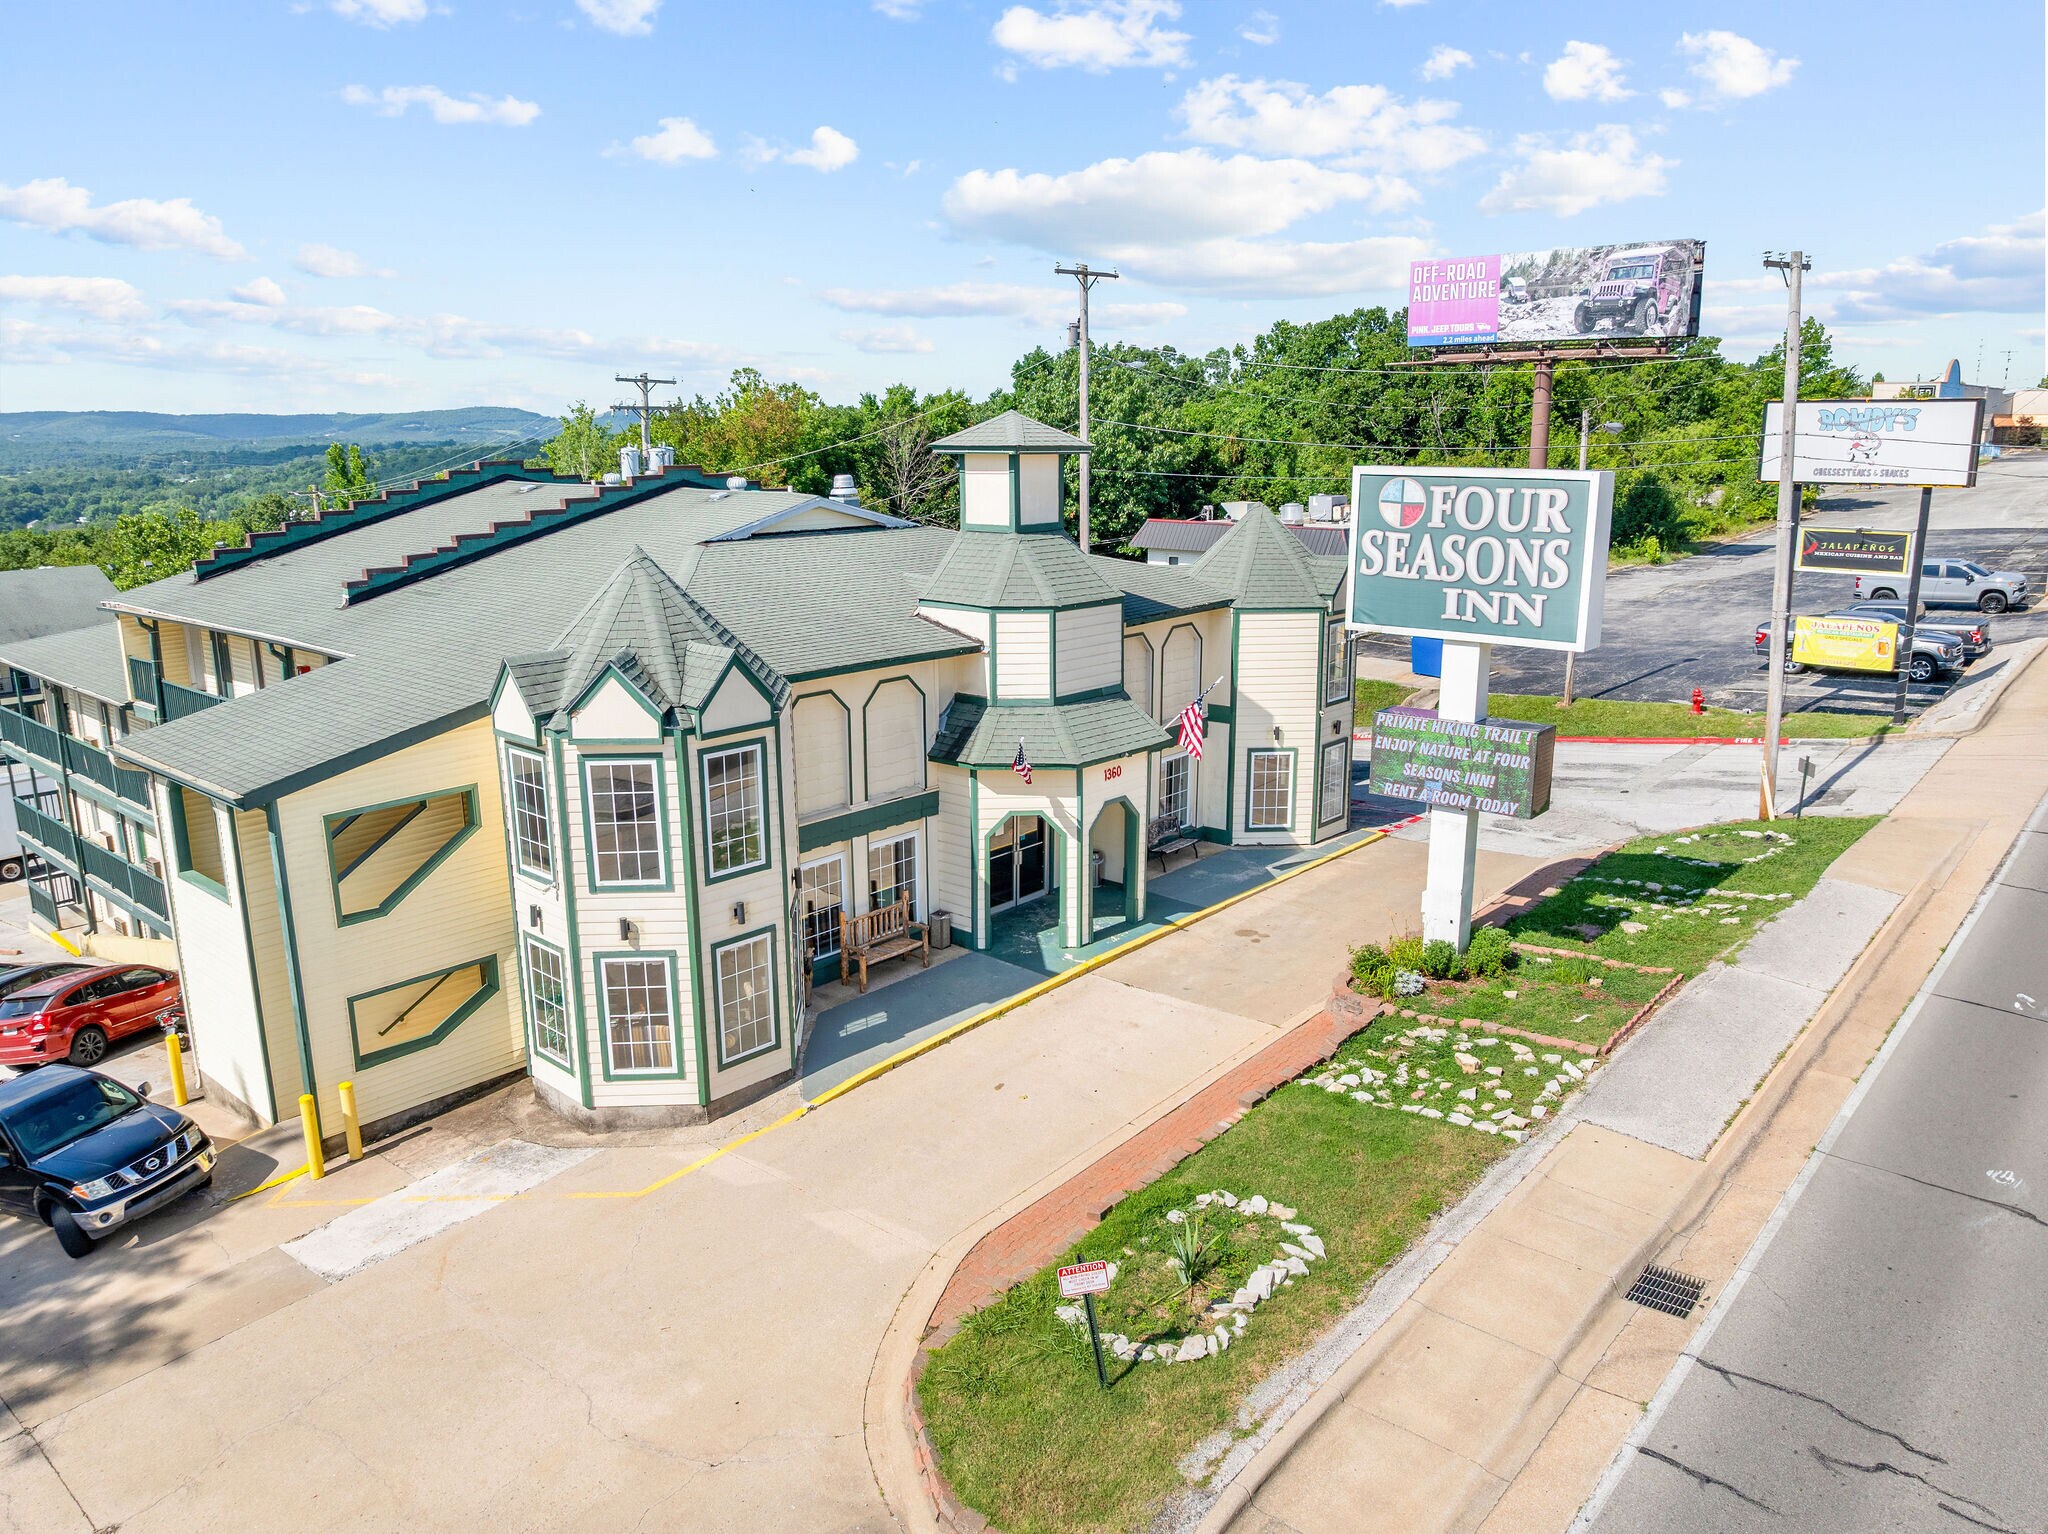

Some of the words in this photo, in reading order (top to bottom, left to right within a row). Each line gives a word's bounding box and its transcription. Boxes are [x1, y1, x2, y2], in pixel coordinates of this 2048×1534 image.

[1414, 262, 1486, 284] OFF-ROAD
[1412, 280, 1497, 303] ADVENTURE
[1443, 336, 1453, 344] 2.2
[1454, 335, 1473, 343] miles
[1474, 334, 1495, 342] ahead
[1451, 323, 1475, 332] TOURS
[1818, 407, 1922, 432] ROWDY'S
[1813, 467, 1872, 477] CHEESESTEAKS
[1879, 469, 1910, 478] SHAKES
[1427, 485, 1572, 534] FOUR
[1360, 529, 1570, 589] SEASONS
[1441, 587, 1548, 627] INN
[1376, 713, 1429, 732] PRIVATE
[1430, 721, 1480, 739] HIKING
[1483, 728, 1522, 744] TRAIL
[1375, 736, 1416, 753] ENJOY
[1418, 742, 1471, 761] NATURE
[1473, 751, 1490, 764] AT
[1493, 753, 1531, 770] FOUR
[1104, 765, 1122, 781] 1360
[1403, 763, 1461, 783] SEASONS
[1463, 772, 1496, 788] INN!
[1384, 782, 1417, 799] RENT
[1418, 789, 1429, 801] A
[1430, 791, 1472, 808] ROOM
[1475, 797, 1520, 816] TODAY
[1062, 1262, 1104, 1276] ATTENTION
